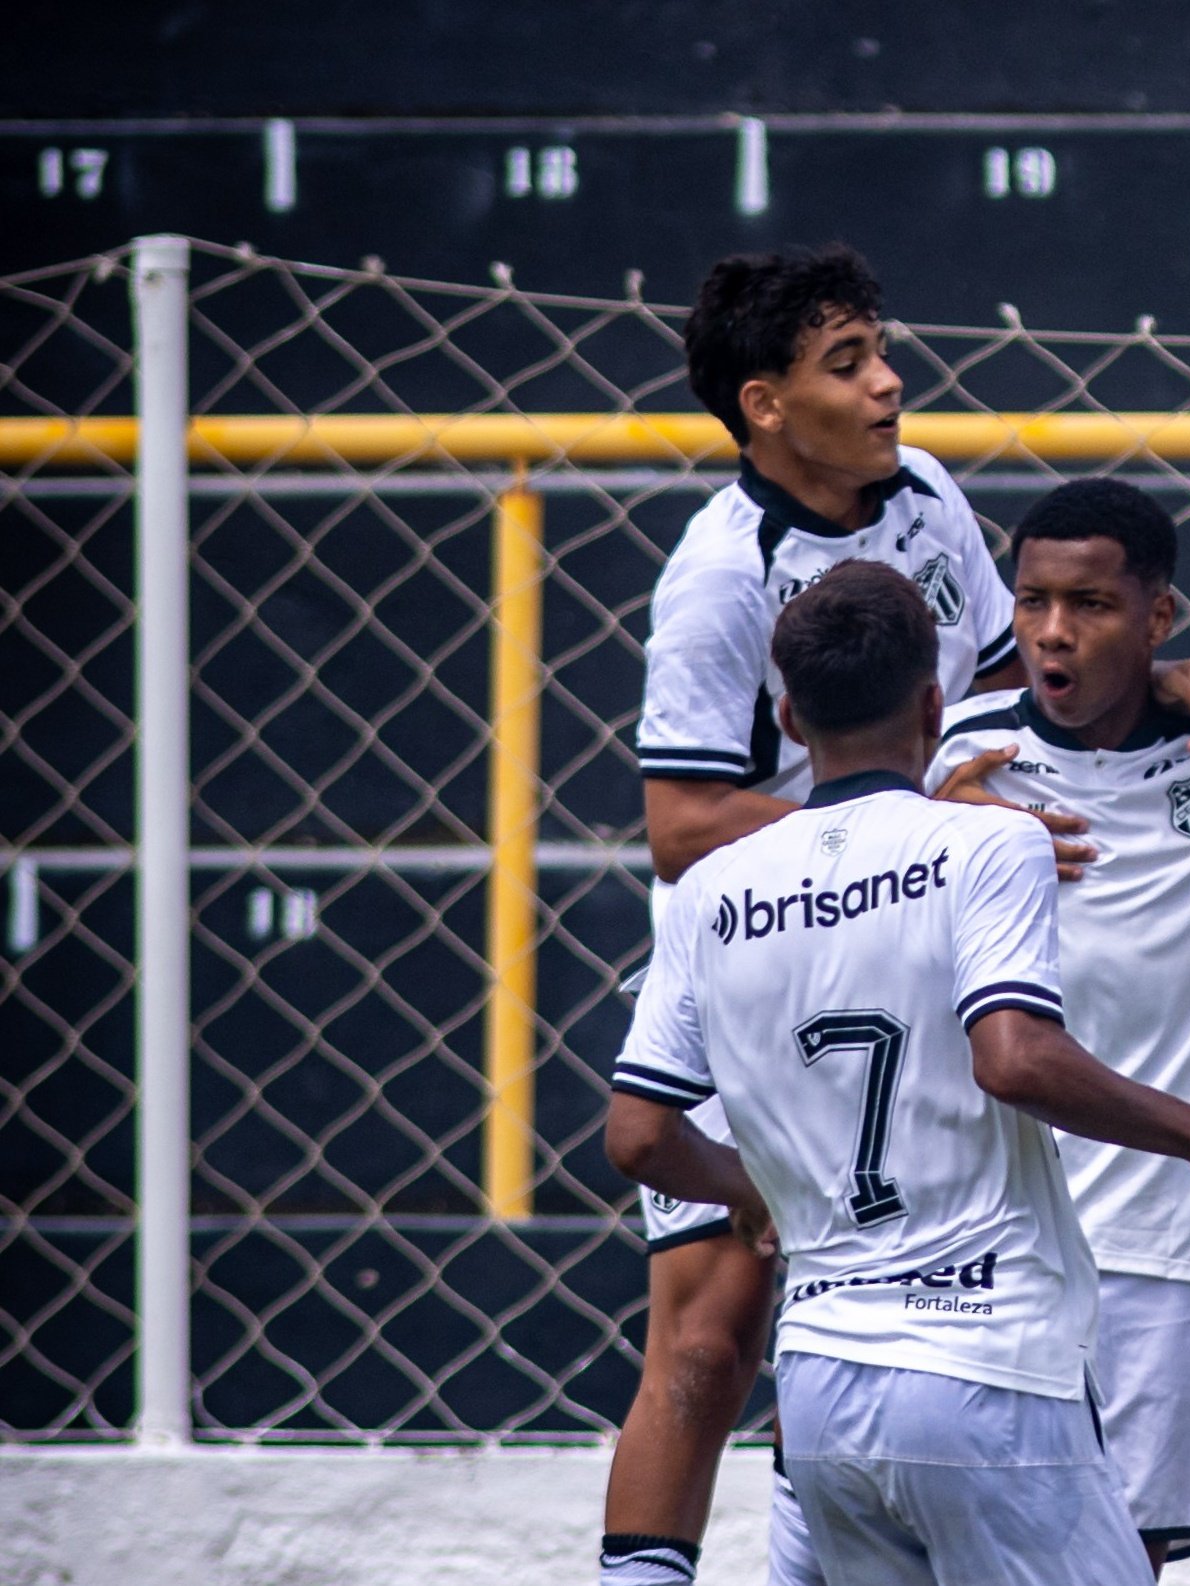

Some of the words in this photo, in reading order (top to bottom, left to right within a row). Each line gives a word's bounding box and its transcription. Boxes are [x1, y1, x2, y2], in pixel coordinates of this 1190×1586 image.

[38, 147, 107, 199] 17
[744, 847, 949, 940] brisanet
[792, 1008, 911, 1230] 7
[904, 1293, 993, 1315] Fortaleza
